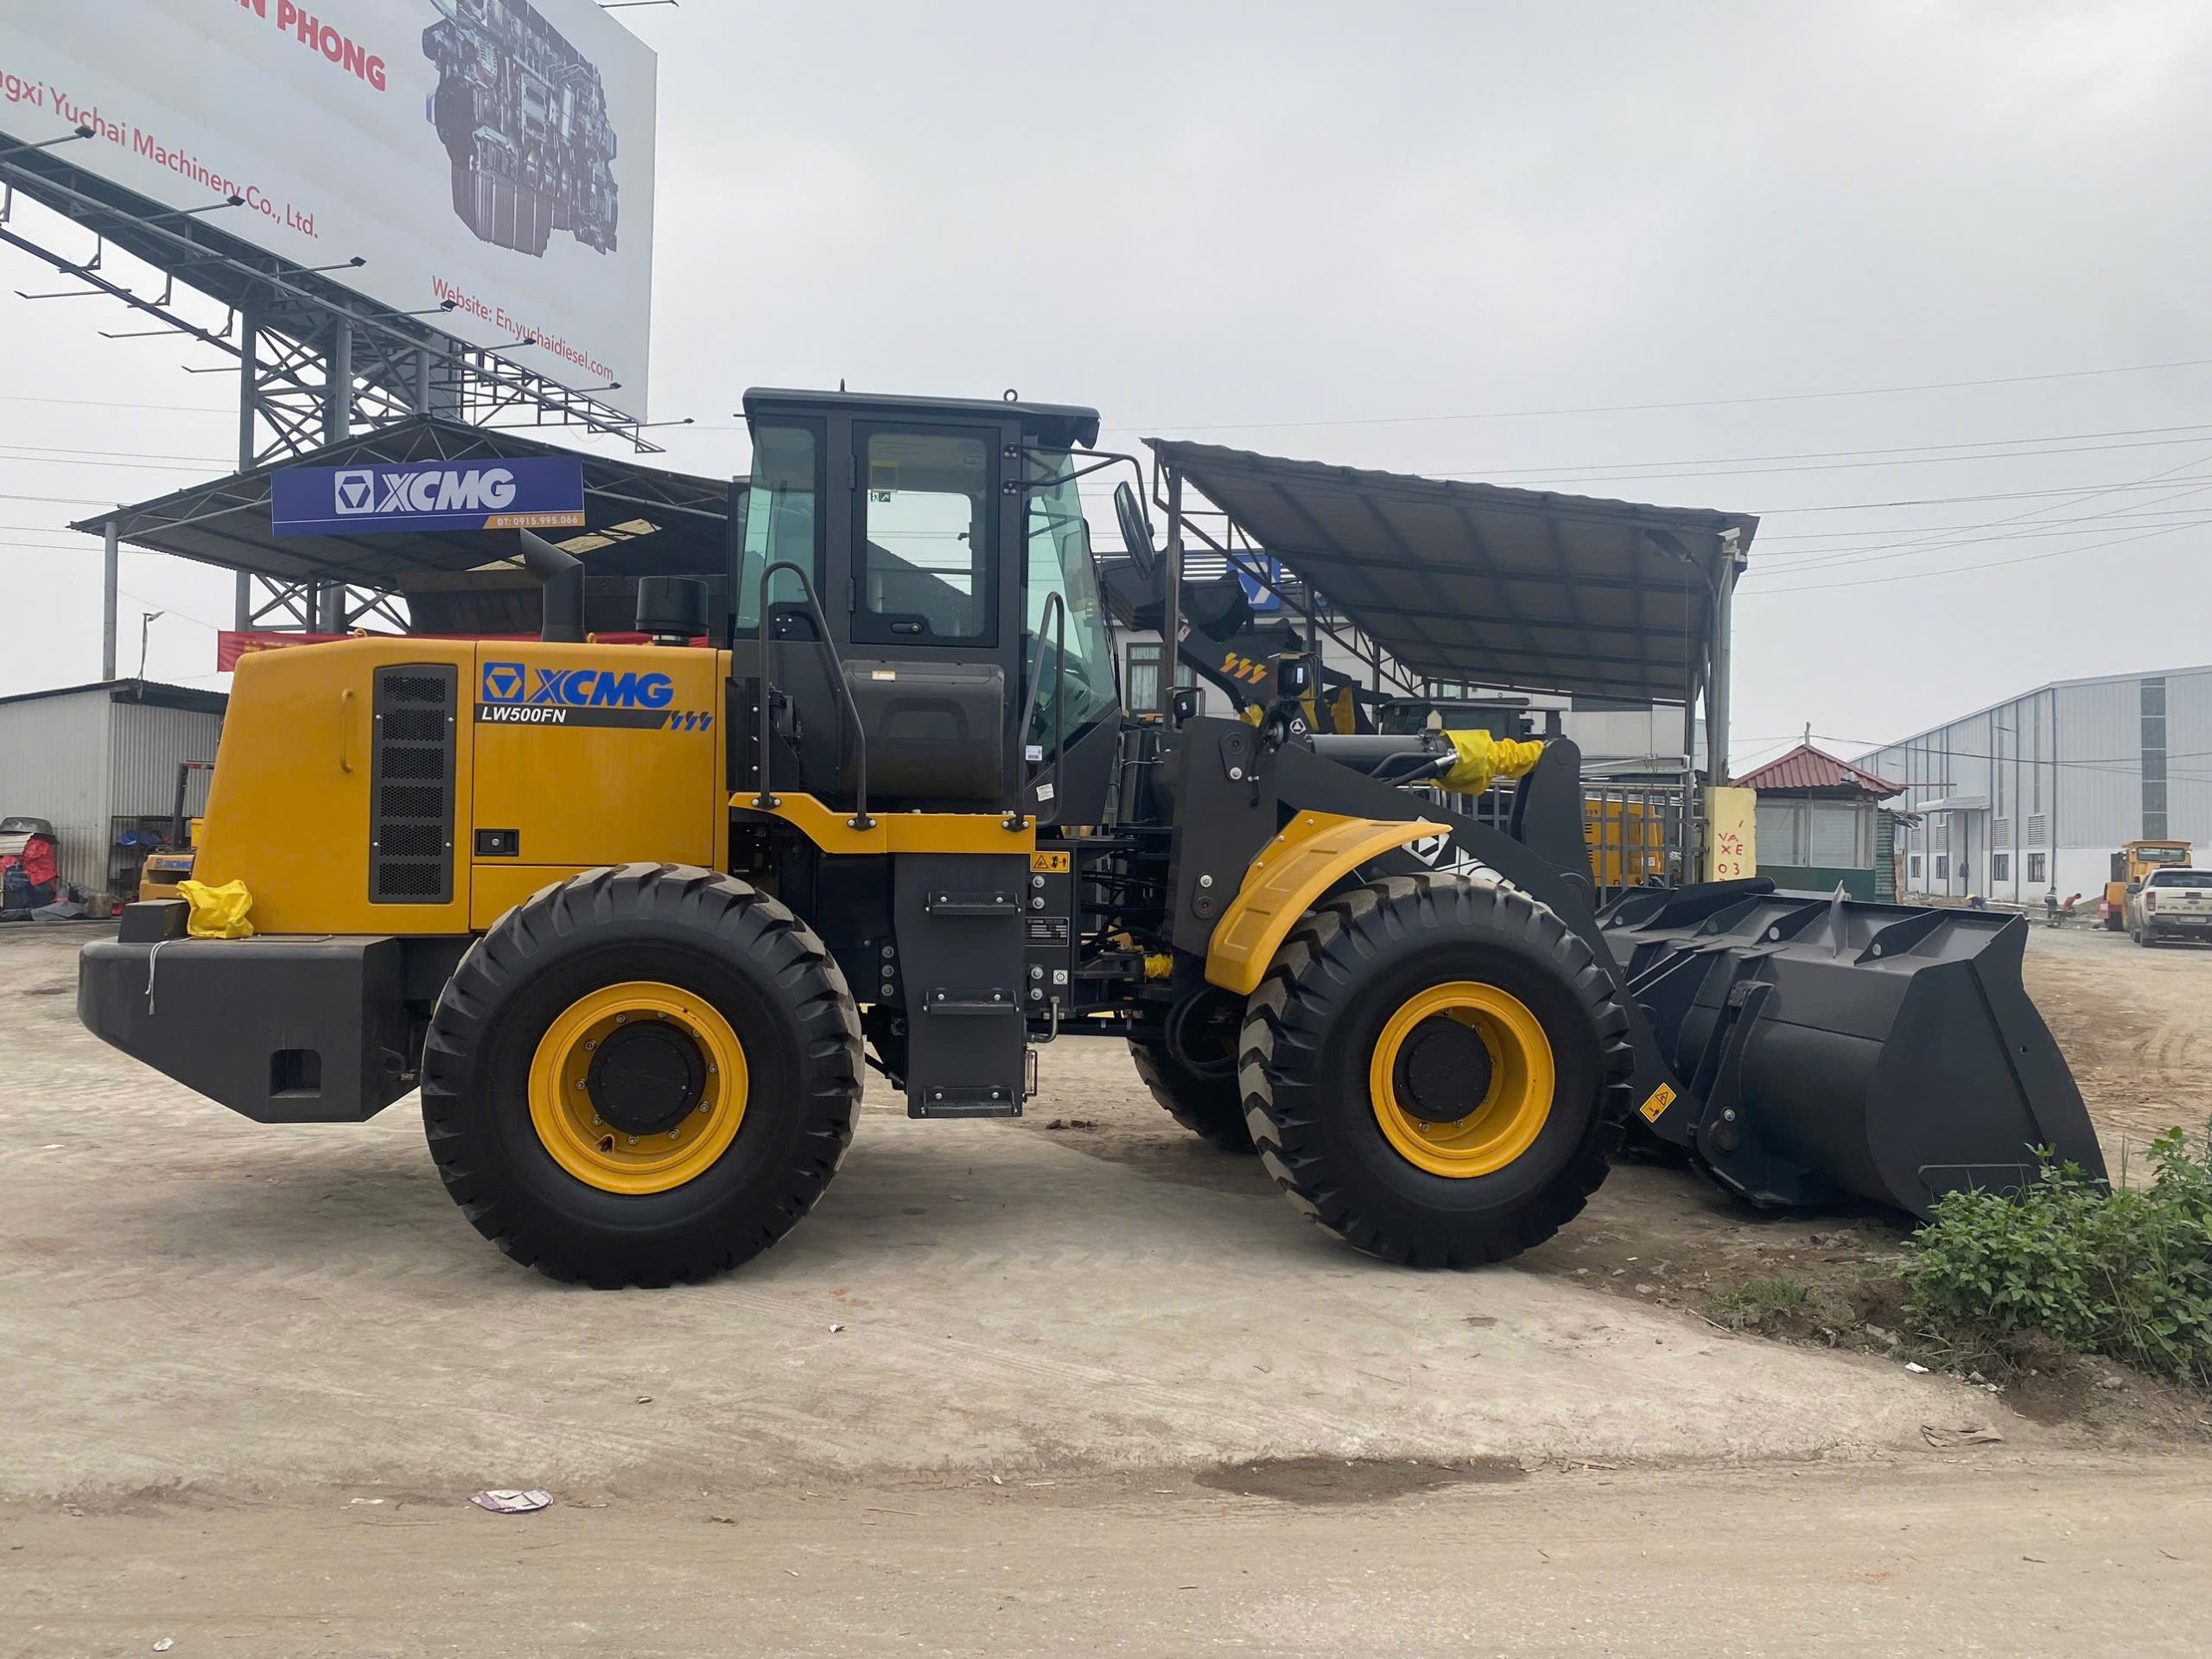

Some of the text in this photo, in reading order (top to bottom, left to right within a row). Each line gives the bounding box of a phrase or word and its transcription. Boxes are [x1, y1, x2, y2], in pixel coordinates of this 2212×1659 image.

[276, 0, 385, 92] PHONG
[49, 86, 126, 146] Yuchai
[133, 128, 241, 198] Machinery
[245, 185, 281, 225] Co.,
[286, 203, 319, 238] Ltd.
[432, 275, 613, 382] Website: En.yuchaidiesel.com
[374, 467, 517, 514] XCMG
[513, 515, 578, 526] 0915.995.066
[524, 669, 675, 709] XCMG
[481, 706, 567, 723] LW500FN
